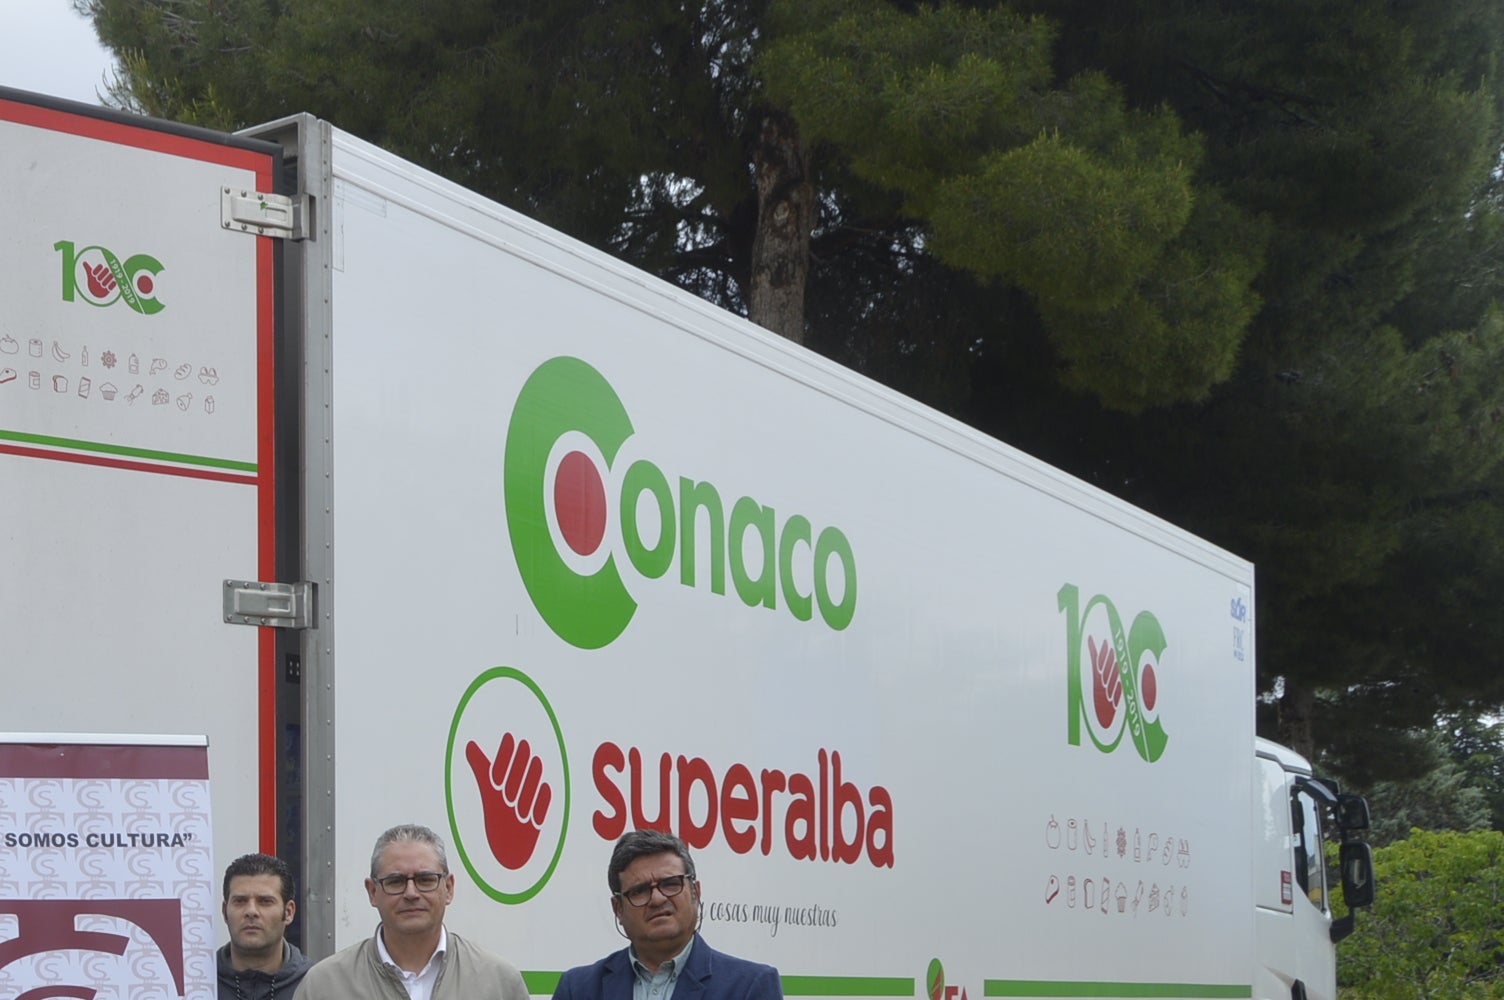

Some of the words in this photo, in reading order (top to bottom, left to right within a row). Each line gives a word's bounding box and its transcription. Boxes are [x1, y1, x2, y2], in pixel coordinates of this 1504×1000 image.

[504, 355, 857, 650] Conaco
[4, 832, 79, 848] SOMOS
[592, 741, 895, 869] superalba
[710, 902, 748, 923] cosas
[752, 904, 780, 938] muy
[784, 903, 838, 928] nuestras
